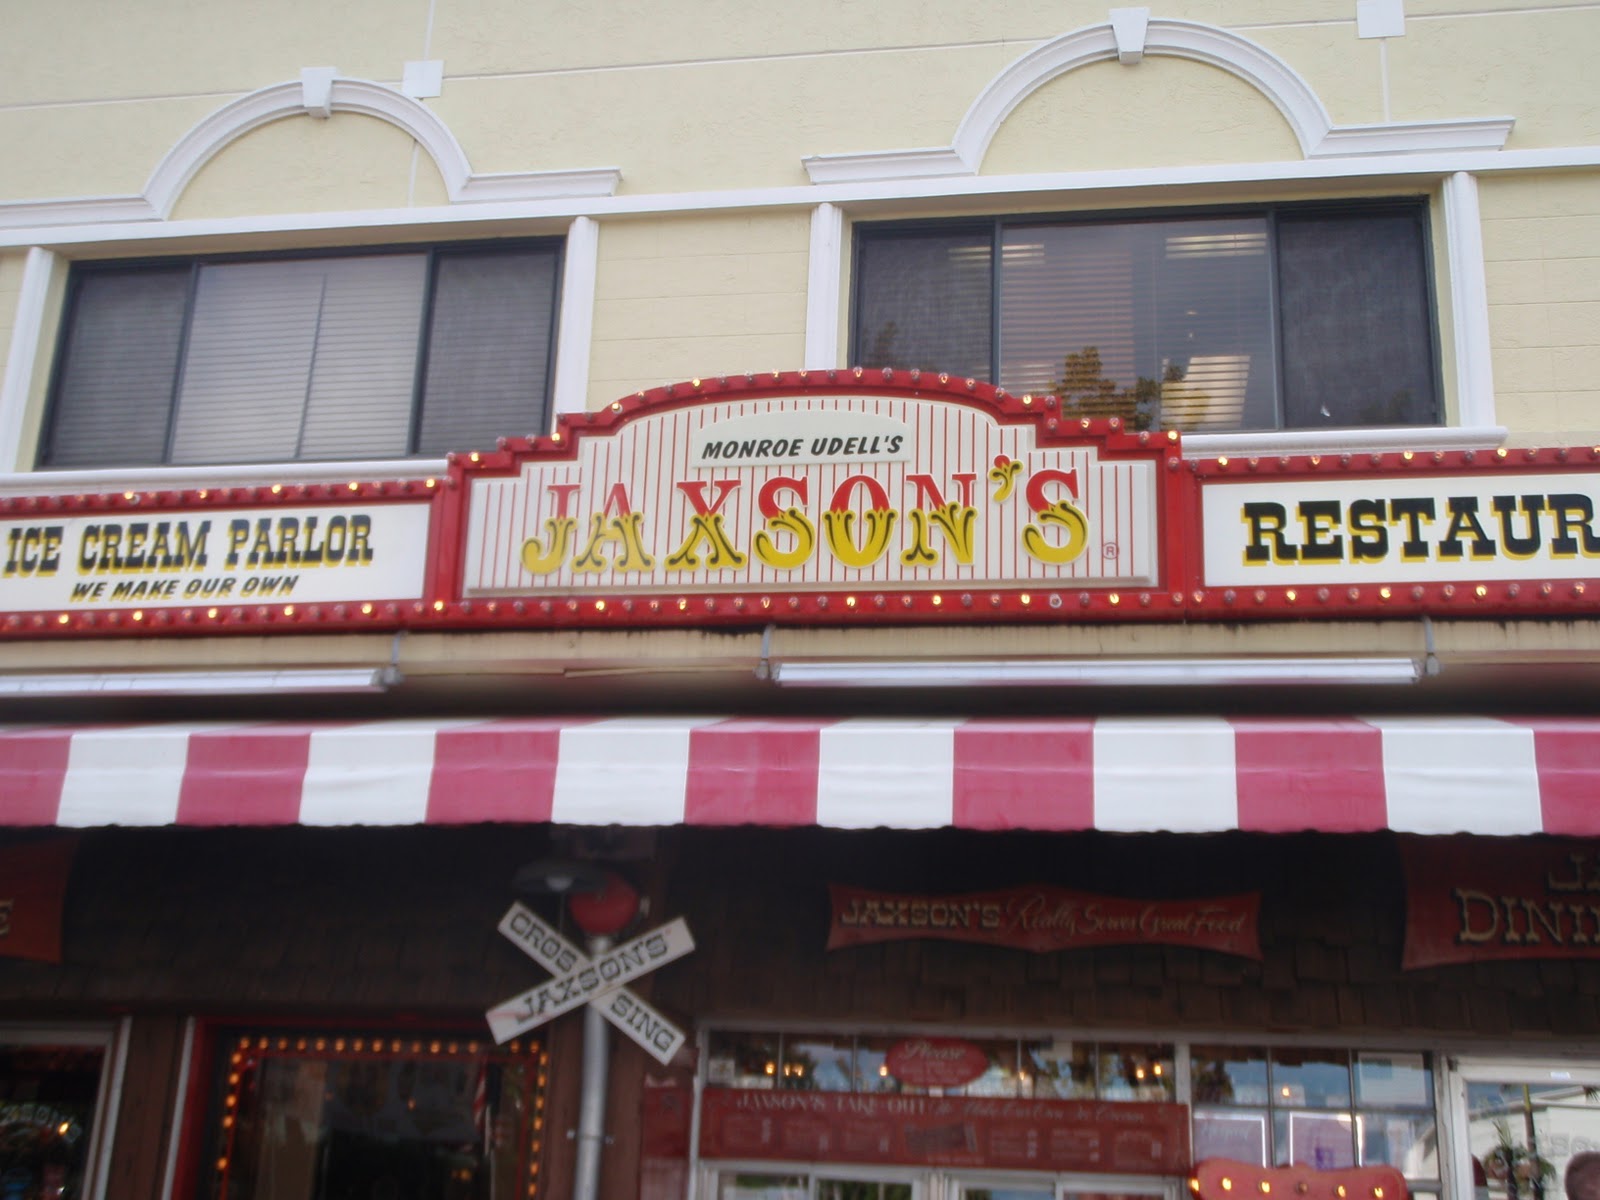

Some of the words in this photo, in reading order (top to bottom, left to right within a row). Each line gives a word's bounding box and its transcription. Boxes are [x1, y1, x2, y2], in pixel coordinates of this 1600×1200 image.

[701, 439, 804, 459] MONROE
[810, 435, 904, 456] UDELL'S
[4, 526, 64, 578] ICE
[77, 520, 212, 575] CREAM
[224, 514, 374, 571] PARLOR
[521, 454, 1090, 577] JAXSON'S
[1241, 493, 1600, 566] RESTAUR
[70, 582, 106, 602] WE
[108, 579, 181, 600] MAKE
[183, 577, 238, 597] OUR
[239, 575, 300, 597] OWN
[508, 911, 578, 974] CROS
[841, 898, 1001, 929] JAXSON'S
[515, 933, 669, 1026] JAXSON'S
[610, 992, 677, 1054] SING
